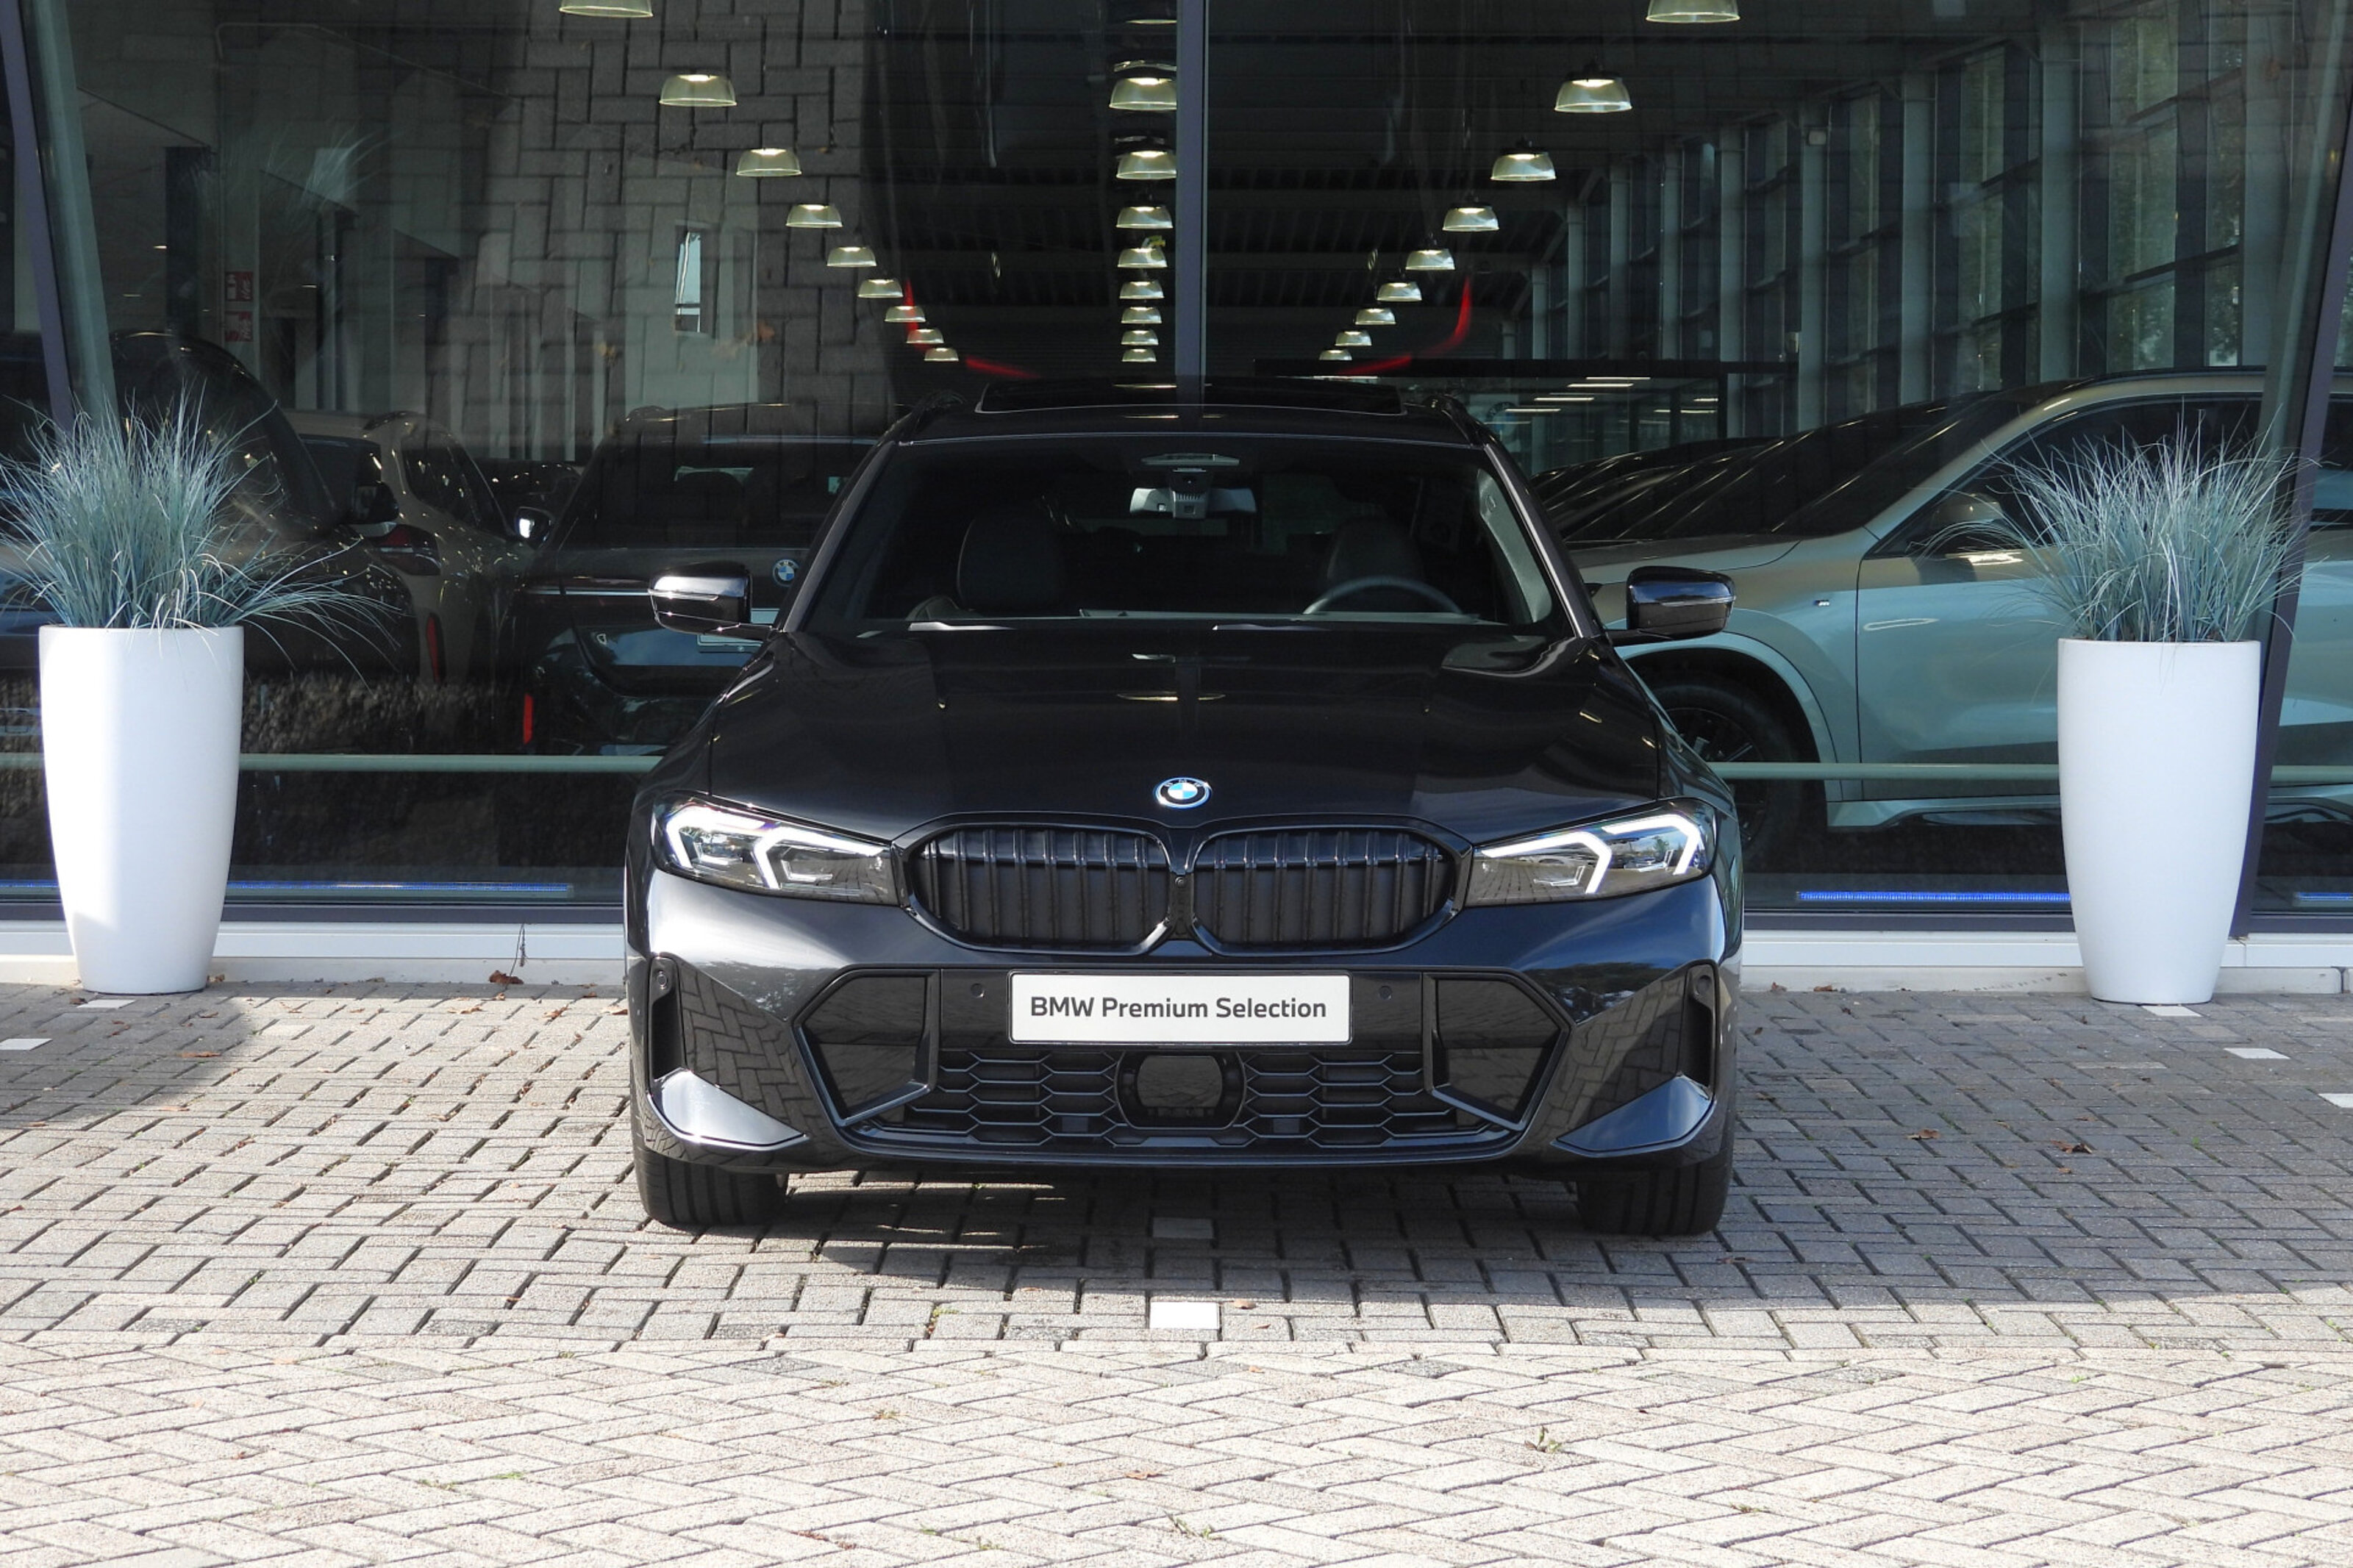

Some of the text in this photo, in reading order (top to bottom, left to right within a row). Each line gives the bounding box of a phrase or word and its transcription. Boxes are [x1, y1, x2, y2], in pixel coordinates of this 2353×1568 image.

[1031, 996, 1327, 1018] BMW Premium Selection
